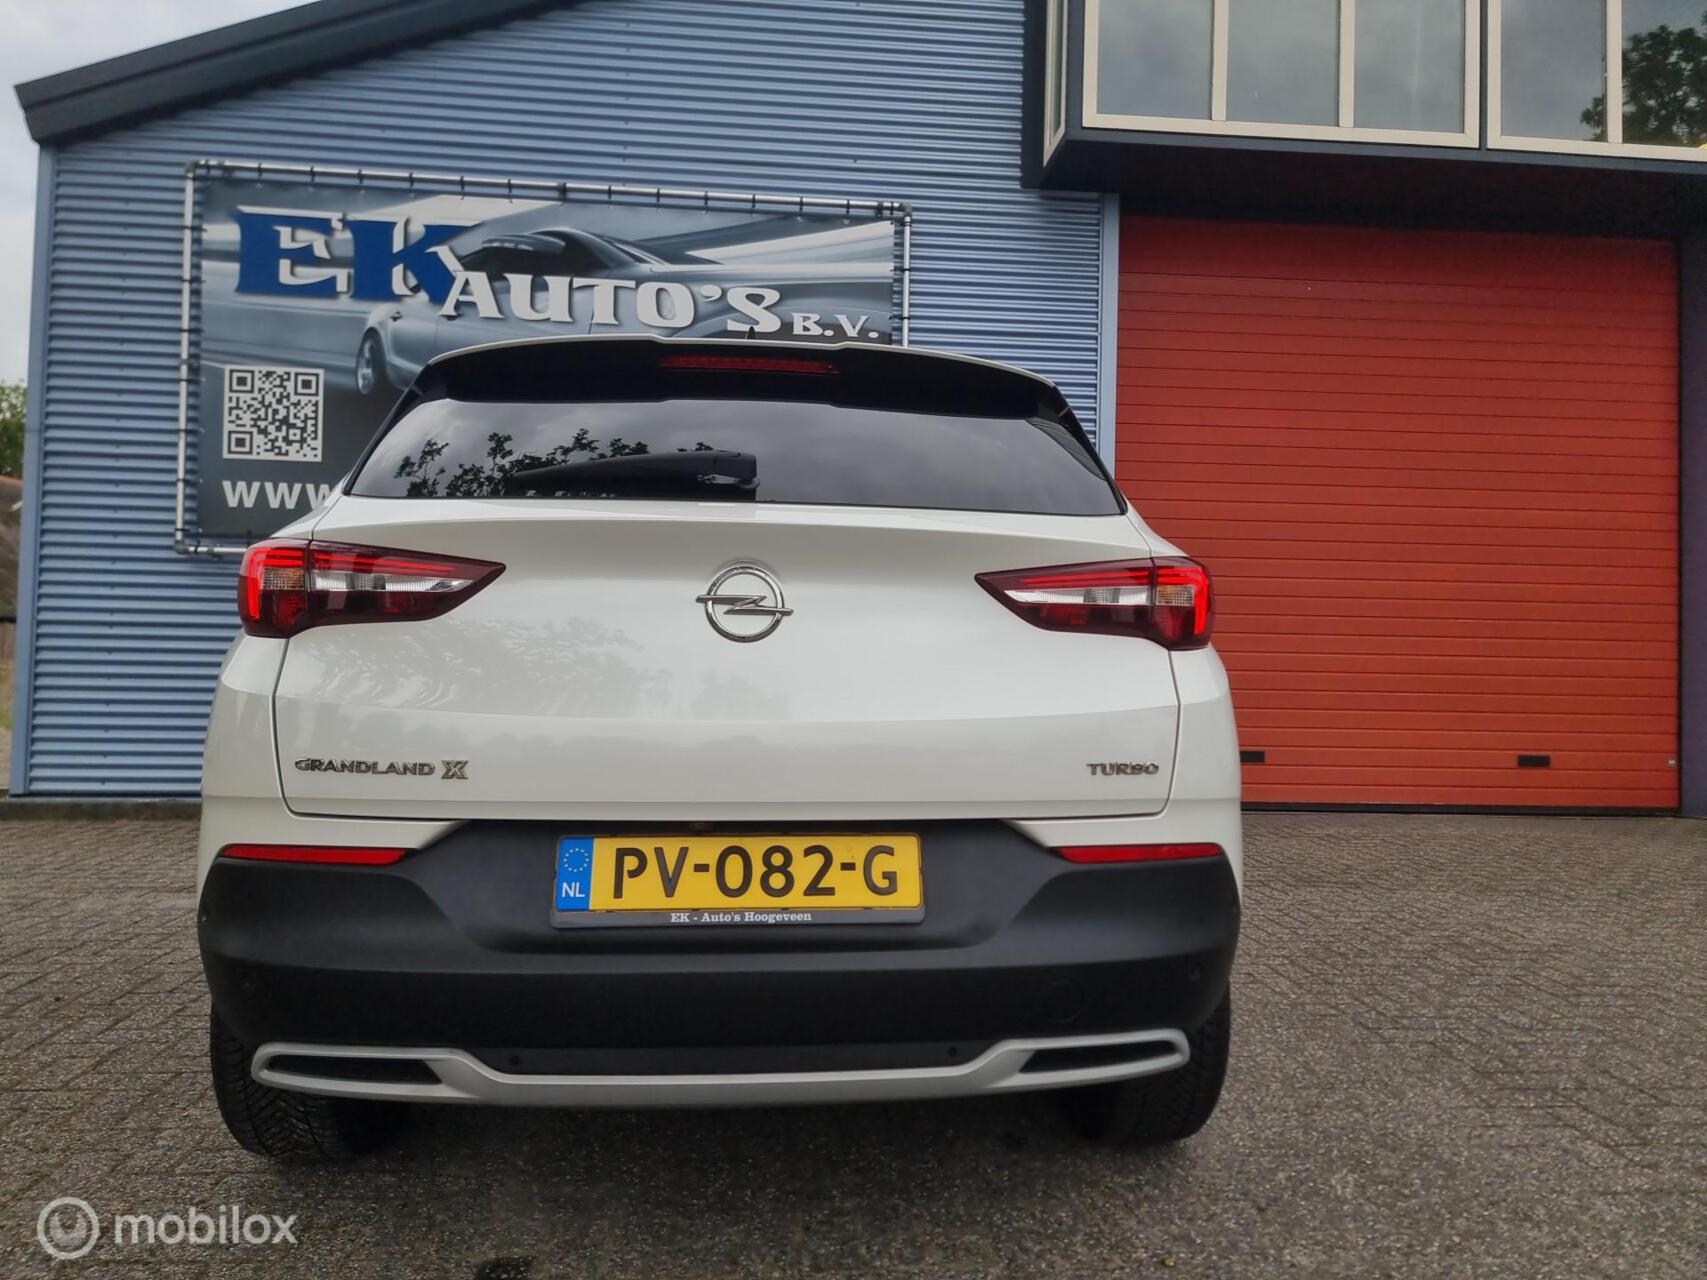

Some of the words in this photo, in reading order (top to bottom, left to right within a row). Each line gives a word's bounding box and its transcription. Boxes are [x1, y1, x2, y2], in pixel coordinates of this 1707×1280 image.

[233, 205, 483, 303] EK
[438, 269, 782, 333] AUTO'S
[791, 312, 880, 339] B.V.
[222, 480, 331, 510] www
[294, 757, 436, 776] GRANDLAND
[440, 759, 469, 780] X
[1086, 761, 1160, 776] TURBO
[612, 844, 899, 899] PV-082-G
[561, 882, 586, 898] NL
[670, 912, 690, 923] EK
[701, 912, 741, 923] Auto's
[743, 911, 812, 924] Hoogeveen
